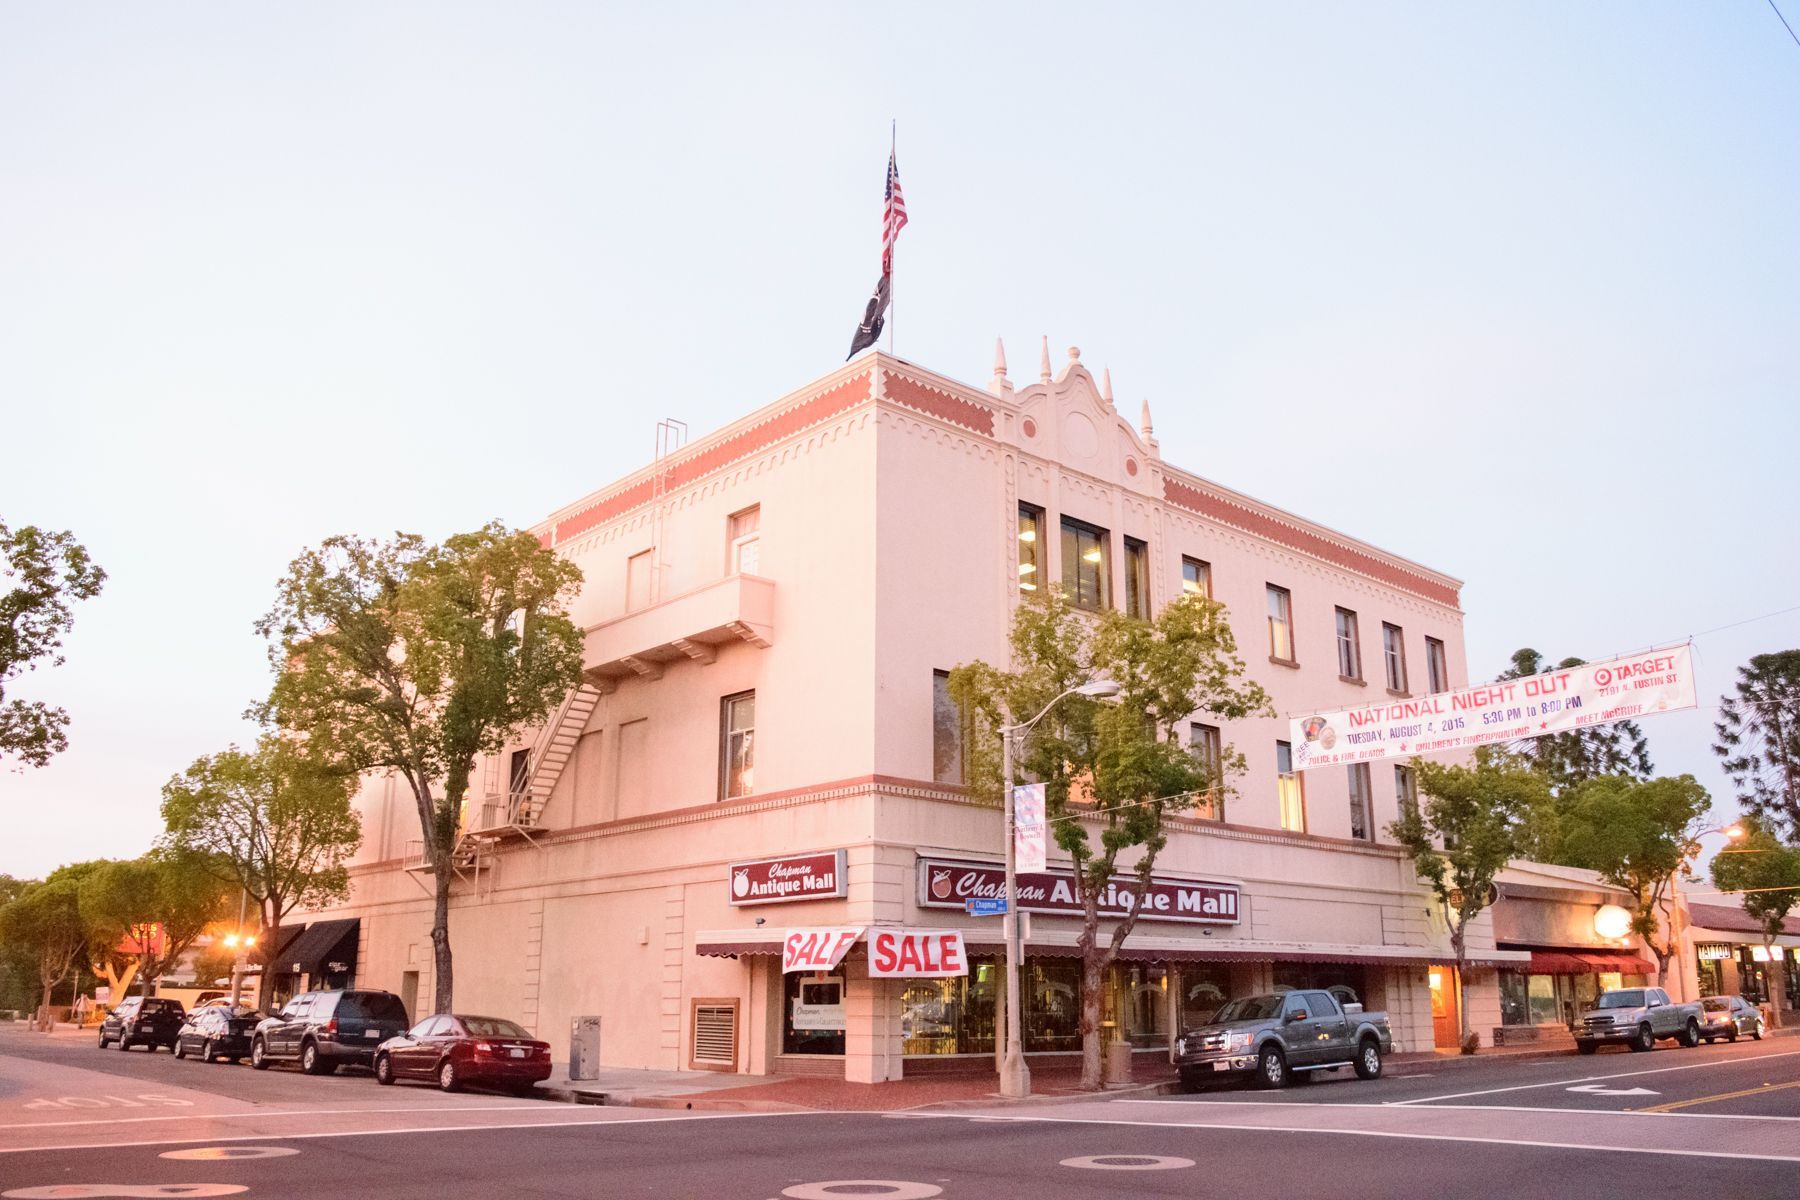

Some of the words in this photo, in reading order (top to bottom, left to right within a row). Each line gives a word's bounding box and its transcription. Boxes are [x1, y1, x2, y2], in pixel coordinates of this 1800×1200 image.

[1613, 656, 1675, 680] TARGET
[1599, 685, 1619, 697] 2191
[1633, 676, 1664, 689] TUSTIN
[1349, 700, 1445, 727] NATIONAL
[1451, 685, 1516, 711] NIGHT
[1525, 674, 1570, 697] OUT
[1347, 730, 1386, 745] TUESDAY,
[1390, 724, 1422, 739] AUGUST
[1442, 717, 1465, 731] 2015
[1483, 711, 1504, 725] 5:30
[1507, 707, 1522, 721] PM
[1541, 700, 1562, 714] 8:00
[1565, 695, 1583, 710] PM
[1575, 713, 1599, 725] MEET
[1601, 704, 1643, 720] McGRUFF
[1308, 753, 1331, 766] POLICE
[1333, 753, 1339, 762] &
[1341, 752, 1355, 761] FIRE
[1359, 748, 1385, 759] DEMOS
[768, 863, 812, 879] Chapman
[750, 878, 801, 896] Antique
[803, 873, 834, 890] Mall
[975, 900, 997, 910] Chapman
[1178, 889, 1236, 914] Mall
[785, 932, 858, 969] SALE
[874, 933, 962, 973] SALE
[1698, 944, 1729, 958] TATTOO
[22, 1094, 195, 1110] STOP
